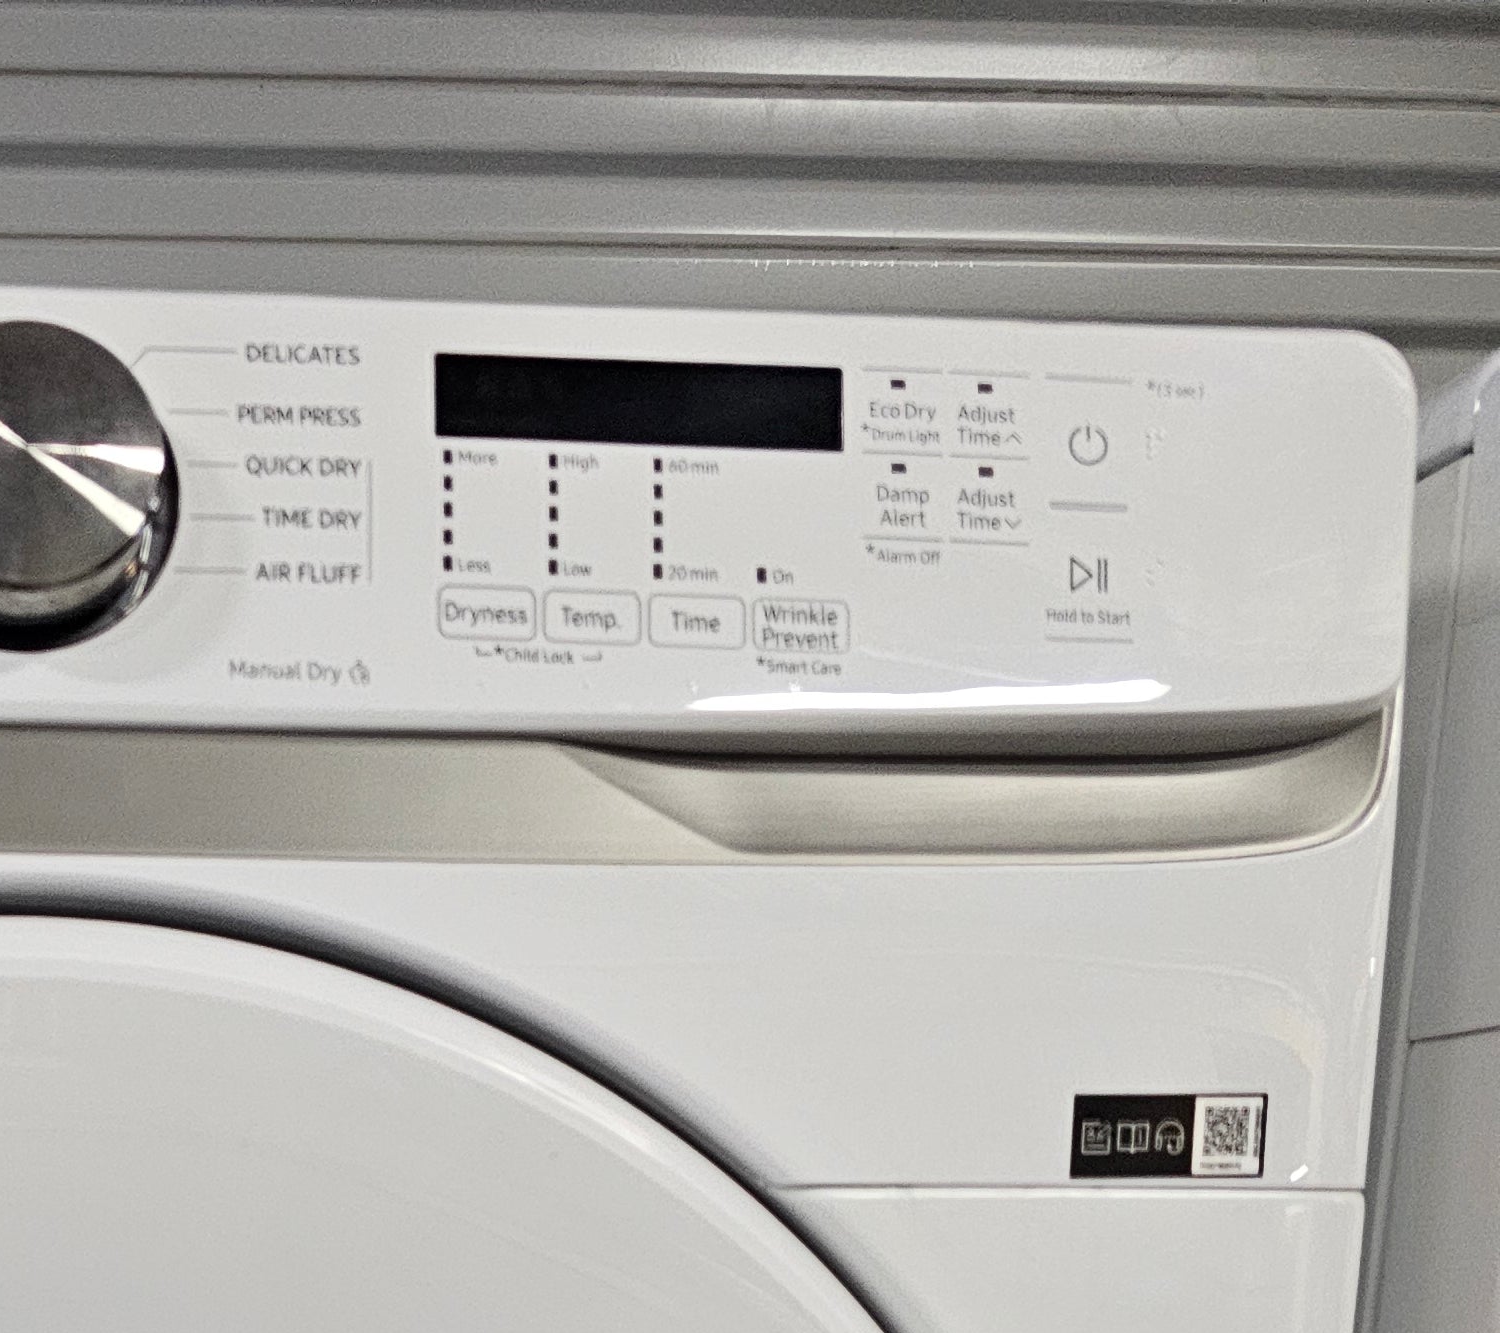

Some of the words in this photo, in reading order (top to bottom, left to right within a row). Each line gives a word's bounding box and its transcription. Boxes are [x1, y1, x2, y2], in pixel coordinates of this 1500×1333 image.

[243, 342, 362, 367] DELICATES
[235, 402, 296, 427] PERM
[299, 404, 364, 429] PRESS
[869, 401, 901, 420] Eco
[904, 401, 937, 422] Dry
[956, 405, 1015, 426] Adjust
[907, 428, 942, 447] Light
[956, 427, 1001, 447] Time
[244, 453, 312, 478] QUICK
[317, 455, 364, 479] DRY
[456, 449, 499, 467] More
[562, 454, 600, 474] High
[690, 457, 721, 477] min
[875, 483, 931, 505] Damp
[956, 489, 1016, 510] Adjust
[260, 505, 315, 530] TIME
[317, 507, 364, 531] DRY
[879, 508, 927, 531] Alert
[956, 513, 1002, 533] Time
[456, 557, 493, 575] Less
[920, 550, 942, 566] Off
[253, 560, 294, 584] AIR
[296, 560, 364, 586] FLUFF
[562, 561, 594, 579] Low
[666, 565, 689, 584] 20
[690, 566, 720, 585] min
[772, 567, 795, 586] On
[443, 598, 529, 626] Dryness
[559, 603, 622, 632] Temp.
[670, 607, 723, 636] Time
[761, 602, 840, 628] Wrinkle
[1046, 606, 1080, 626] Hold
[1080, 609, 1096, 626] to
[1097, 608, 1132, 627] Start
[761, 625, 840, 653] Prevent
[542, 650, 576, 667] Lock
[811, 660, 843, 678] Care
[227, 658, 302, 684] Manual
[305, 661, 343, 688] Dry
